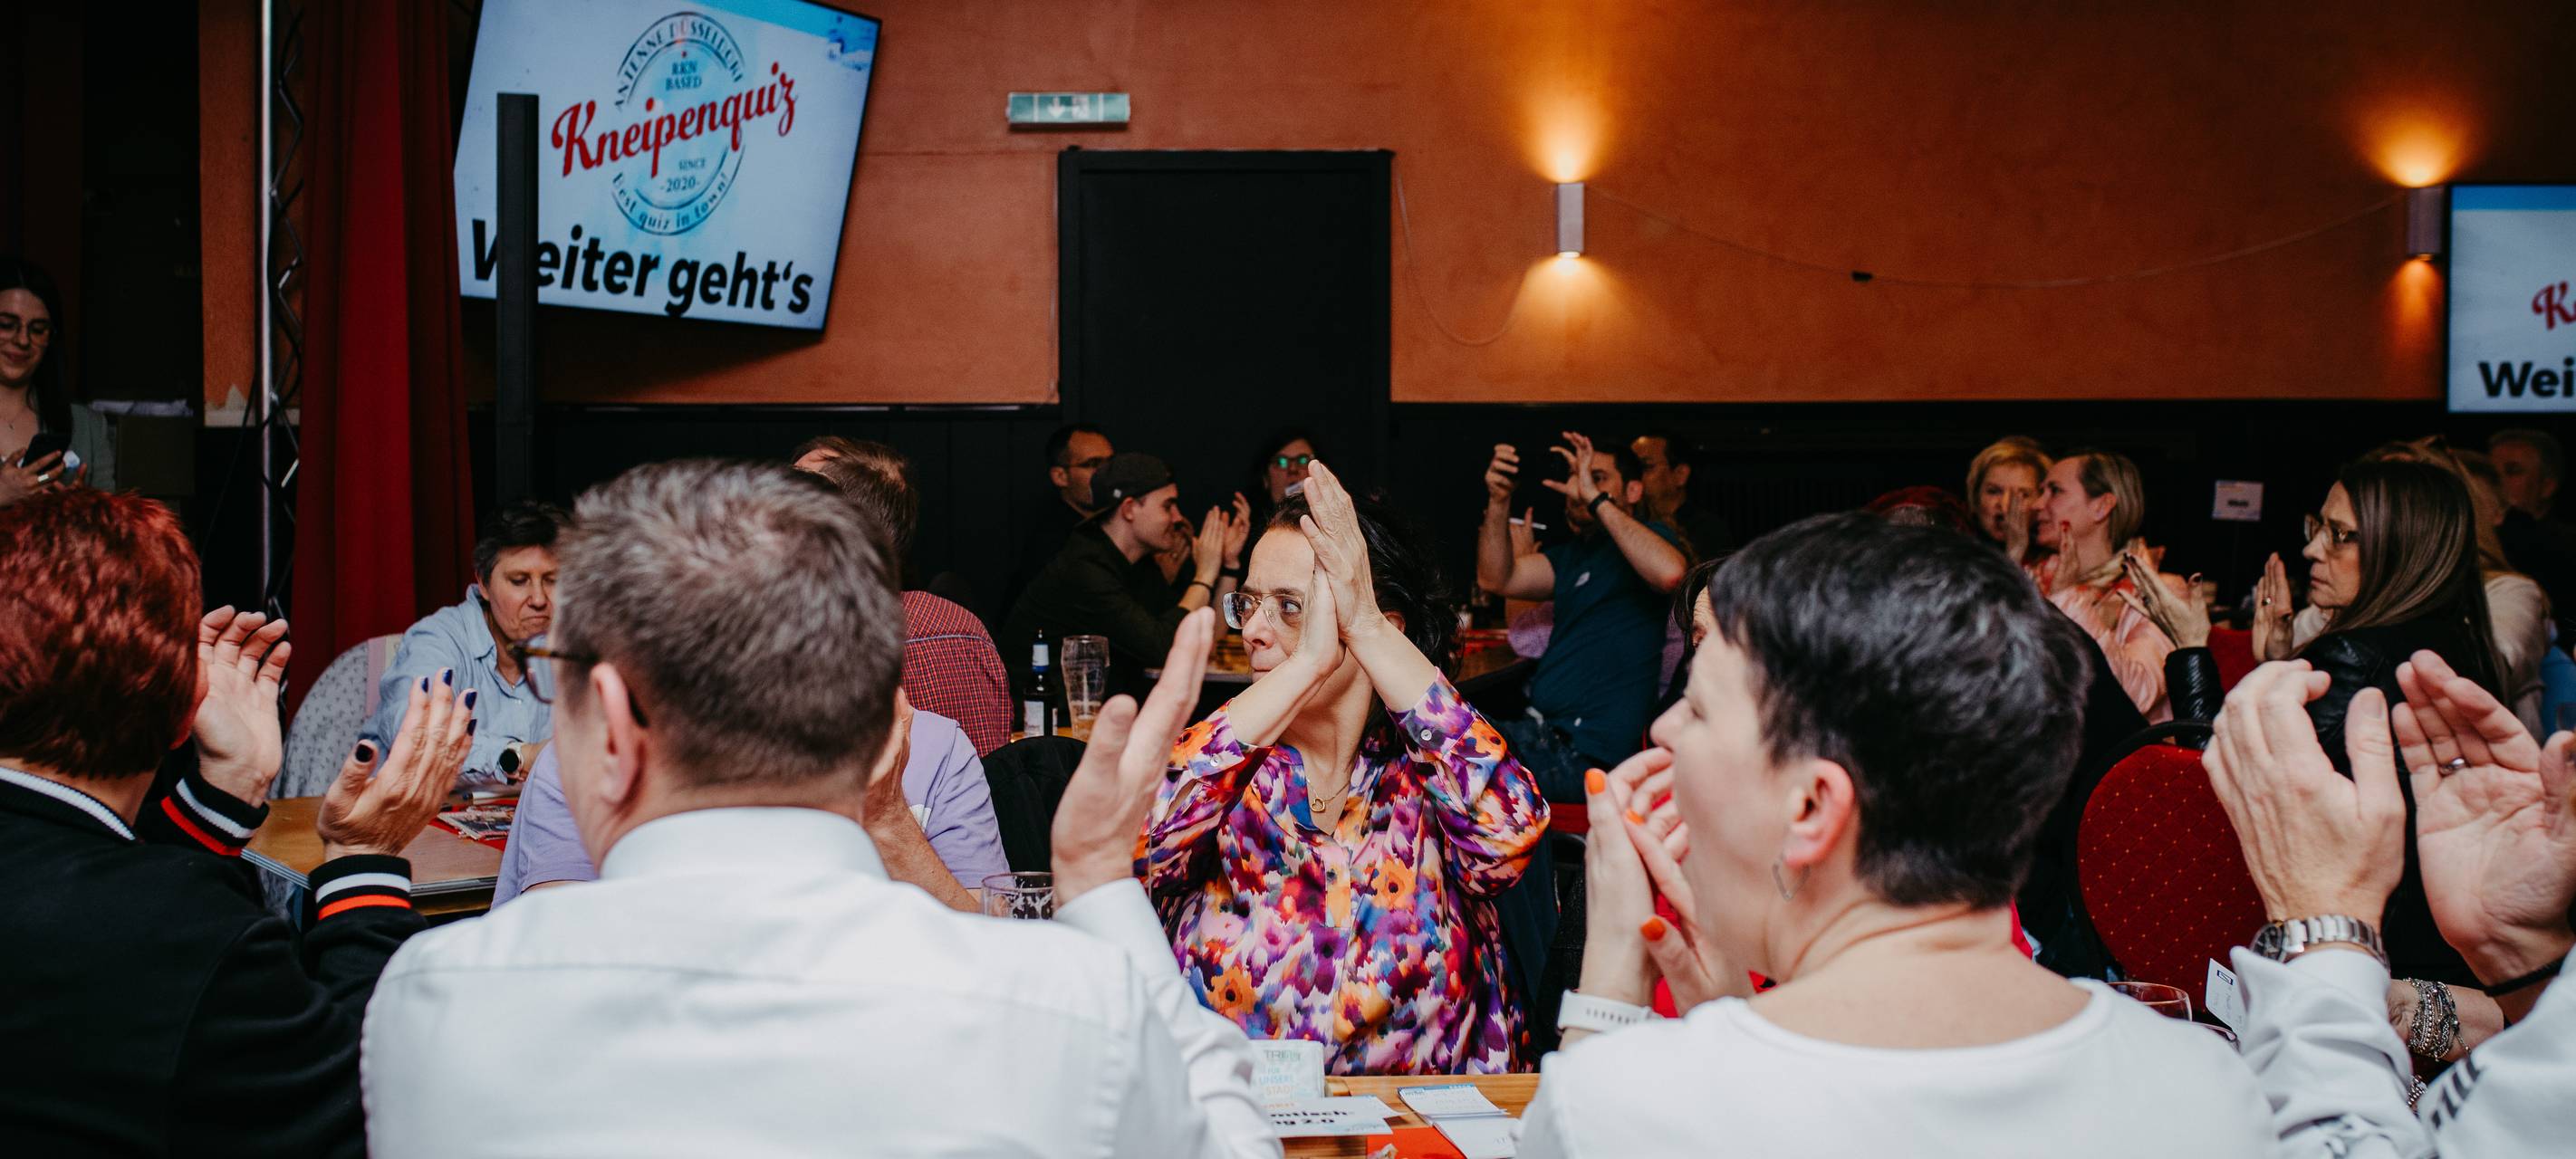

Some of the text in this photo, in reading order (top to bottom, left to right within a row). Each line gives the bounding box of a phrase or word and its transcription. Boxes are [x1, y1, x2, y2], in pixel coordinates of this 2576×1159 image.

[666, 76, 702, 91] BASED
[552, 62, 797, 178] Kneipenquiz
[679, 158, 705, 170] SINCE
[639, 211, 669, 230] quiz
[676, 212, 690, 228] in
[2532, 280, 2576, 331] K
[2477, 355, 2576, 398] Wei
